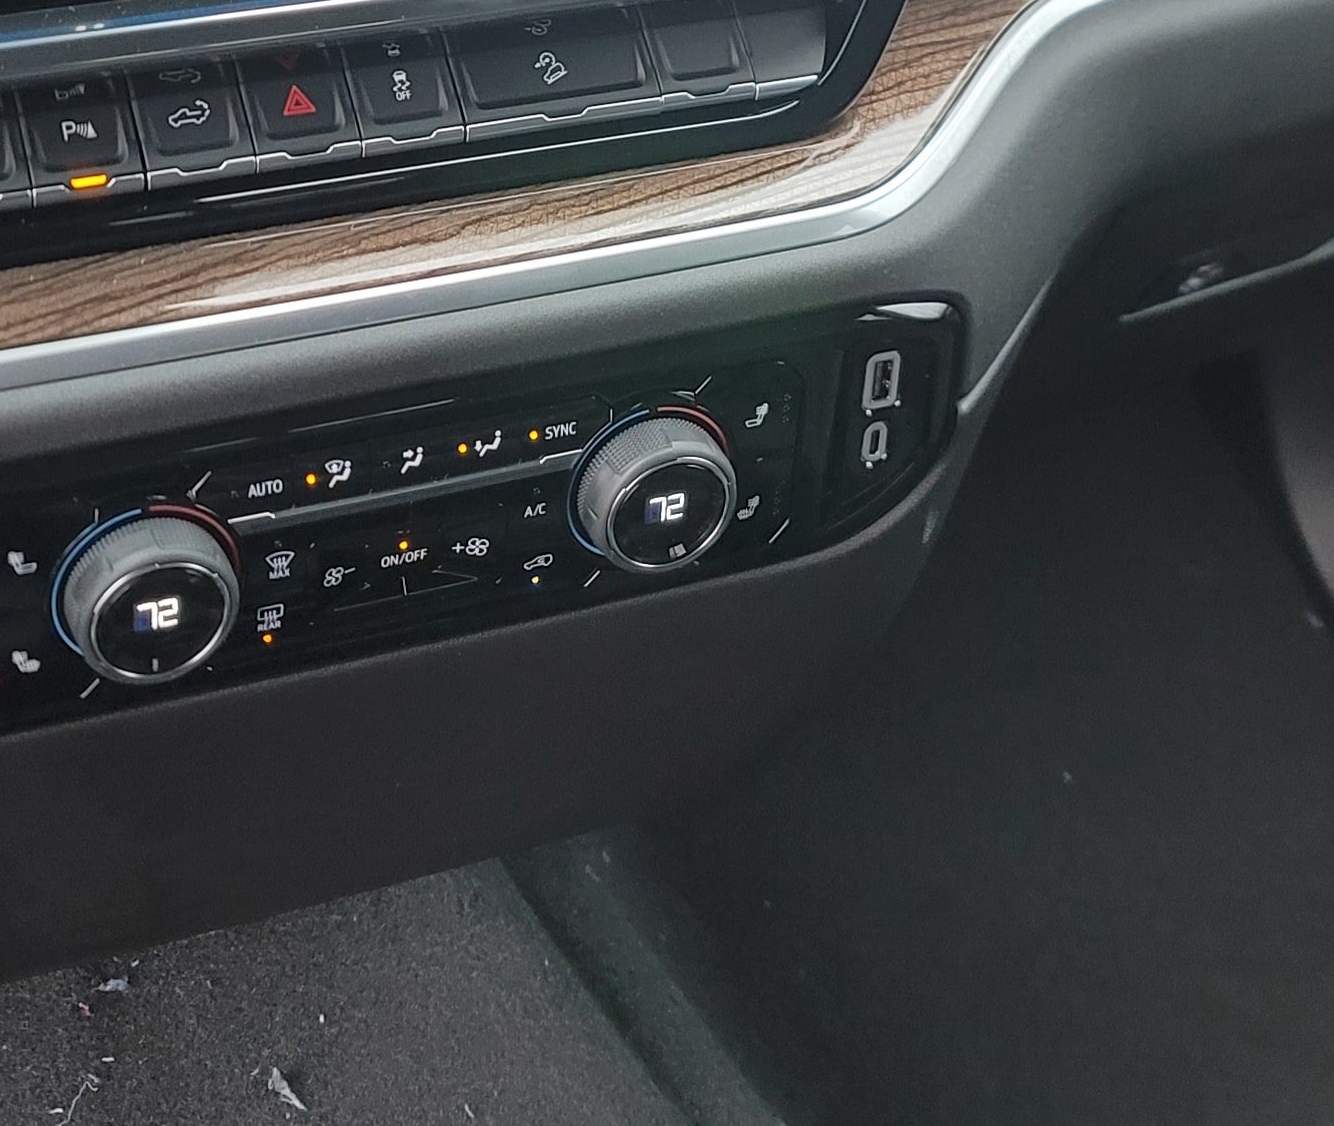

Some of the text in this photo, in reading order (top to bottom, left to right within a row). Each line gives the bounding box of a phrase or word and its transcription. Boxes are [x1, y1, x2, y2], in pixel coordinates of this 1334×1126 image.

[396, 89, 412, 101] OFF
[61, 120, 77, 142] P
[545, 421, 577, 440] SYNC
[248, 479, 284, 499] AUTO
[524, 503, 547, 519] A/C
[648, 492, 685, 522] 72
[380, 548, 428, 569] ON/OFF
[269, 567, 291, 580] MAX
[135, 597, 180, 630] 72
[257, 620, 282, 632] REAR
